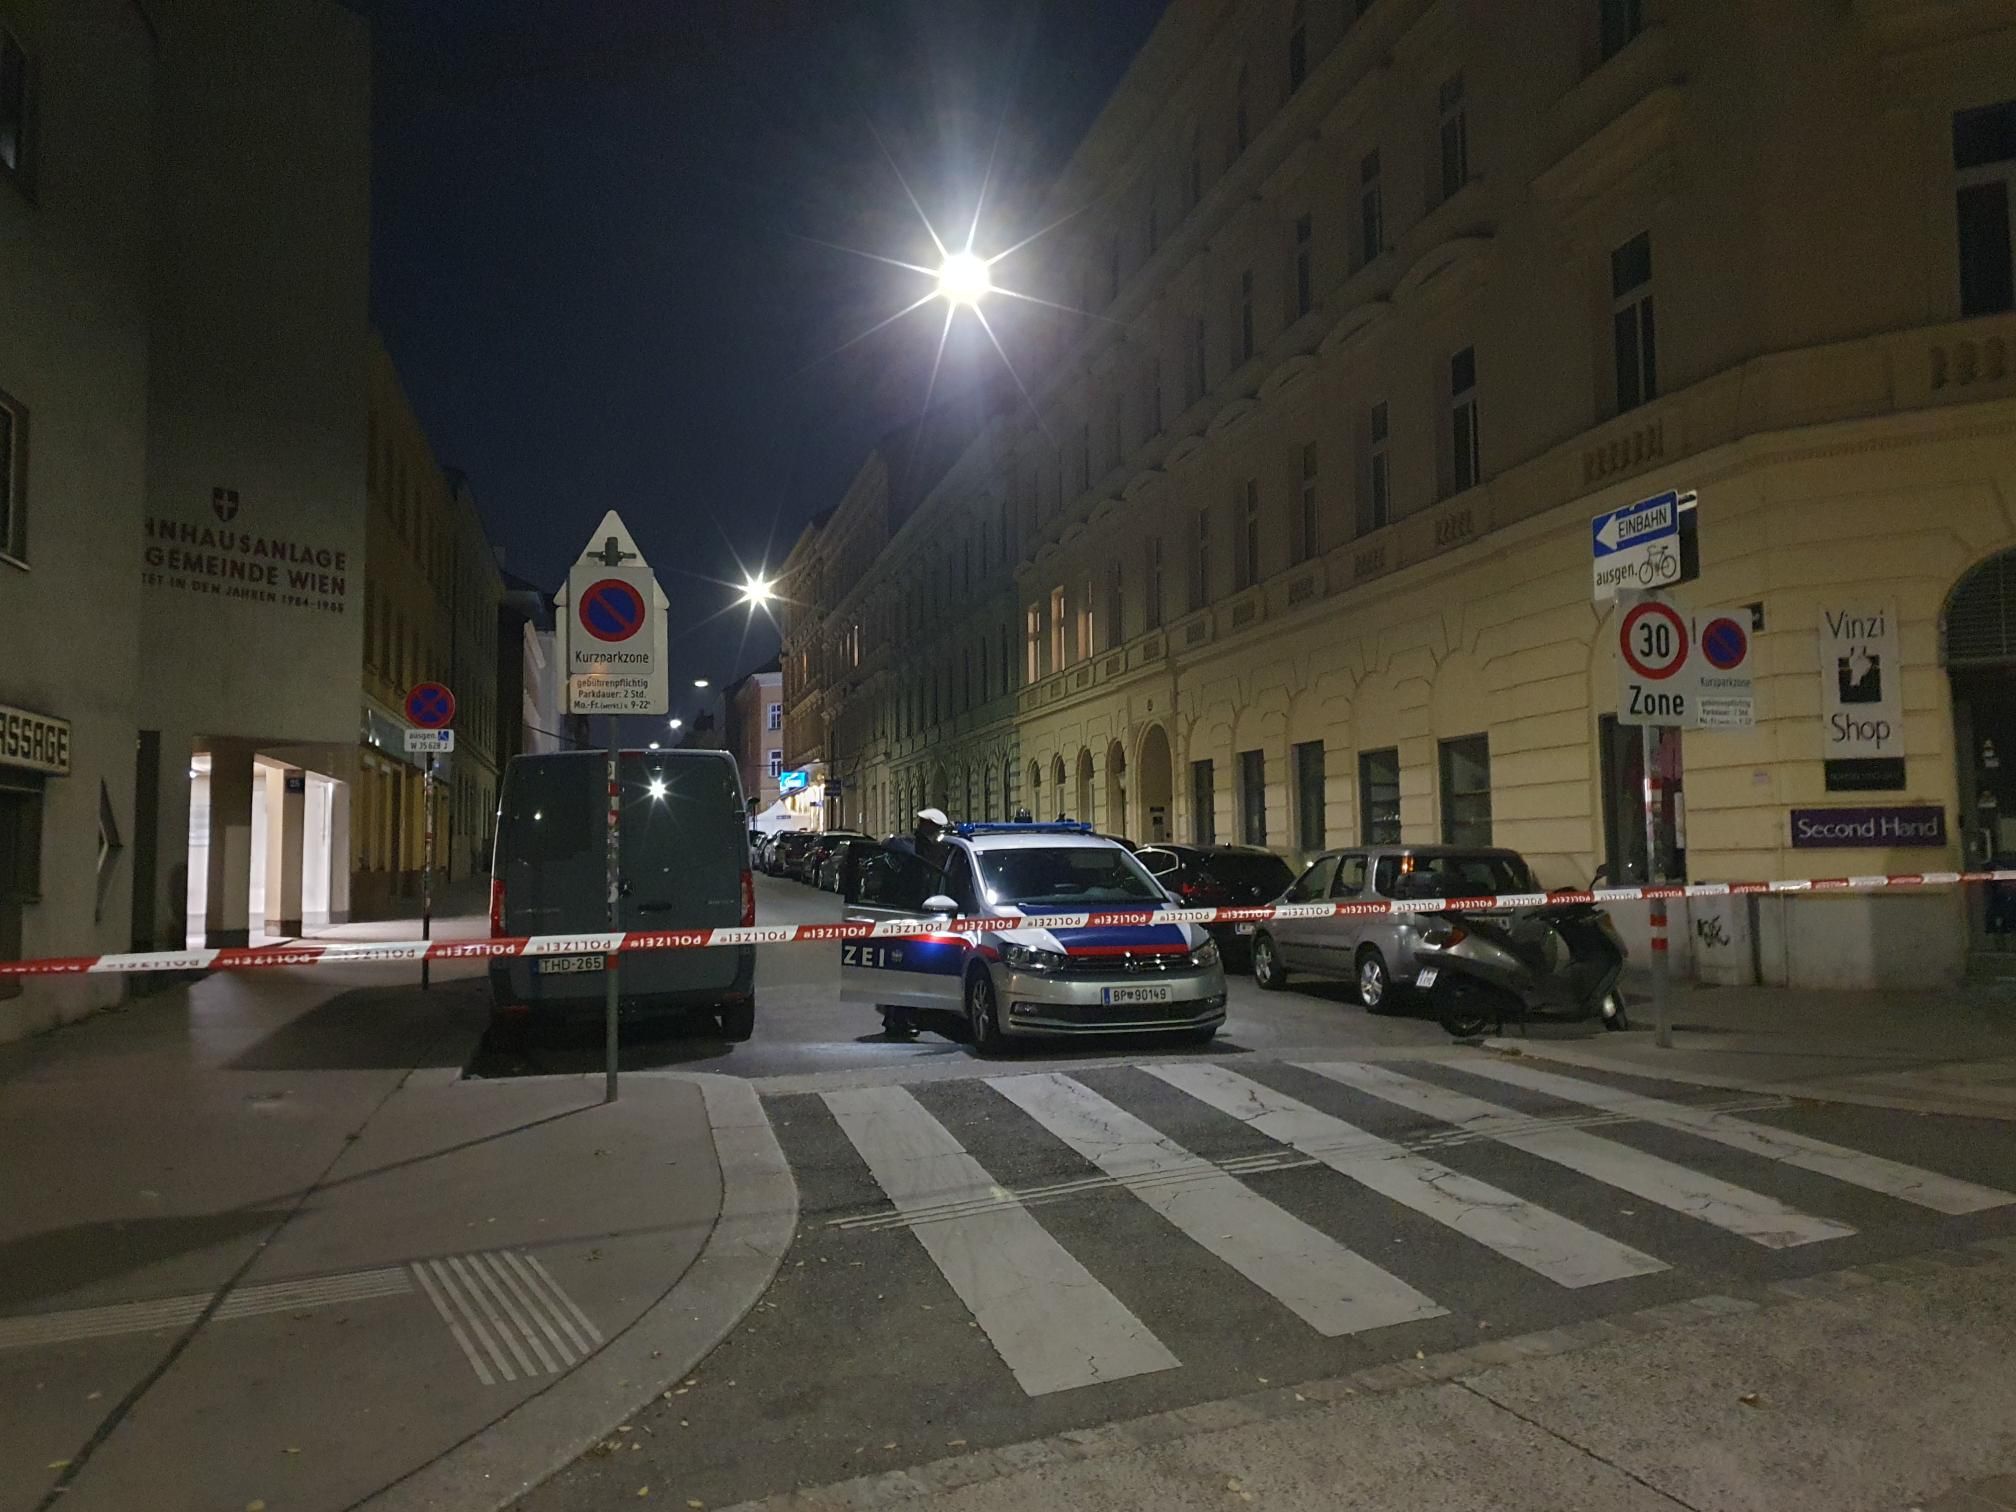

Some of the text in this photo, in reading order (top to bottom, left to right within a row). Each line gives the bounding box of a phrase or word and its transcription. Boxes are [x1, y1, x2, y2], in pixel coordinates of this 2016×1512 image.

[1618, 508, 1667, 538] EINBAHN
[144, 546, 345, 595] GEMEINDE WIEN
[1596, 563, 1638, 586] ausgen.
[1825, 609, 1885, 639] Vinzi
[1639, 622, 1670, 658] 30
[575, 650, 649, 665] Kurzparkzone
[624, 690, 628, 698] 2
[631, 689, 646, 699] Std.
[1629, 685, 1684, 715] Zone
[1830, 713, 1890, 750] Shop
[1797, 815, 1938, 838] Second Hand
[1288, 906, 1330, 917] POLIZEI
[1346, 904, 1386, 915] POLIZEI
[1402, 902, 1441, 912] POLIZEI
[1034, 916, 1081, 928] POLIZEI
[1102, 912, 1147, 925] POLIZEI
[1166, 911, 1210, 921] POLIZEI
[890, 923, 942, 934] POLIZEI
[964, 919, 1013, 931] POLIZEI
[729, 930, 787, 943] POLIZEI
[811, 926, 866, 939] POLIZEI
[547, 940, 611, 952] POLIZEI
[641, 935, 702, 948] POLIZEI
[447, 944, 515, 957] POLIZEI
[843, 945, 886, 968] ZEI
[544, 957, 601, 972] THD-265
[1113, 988, 1166, 1001] BP 90149
